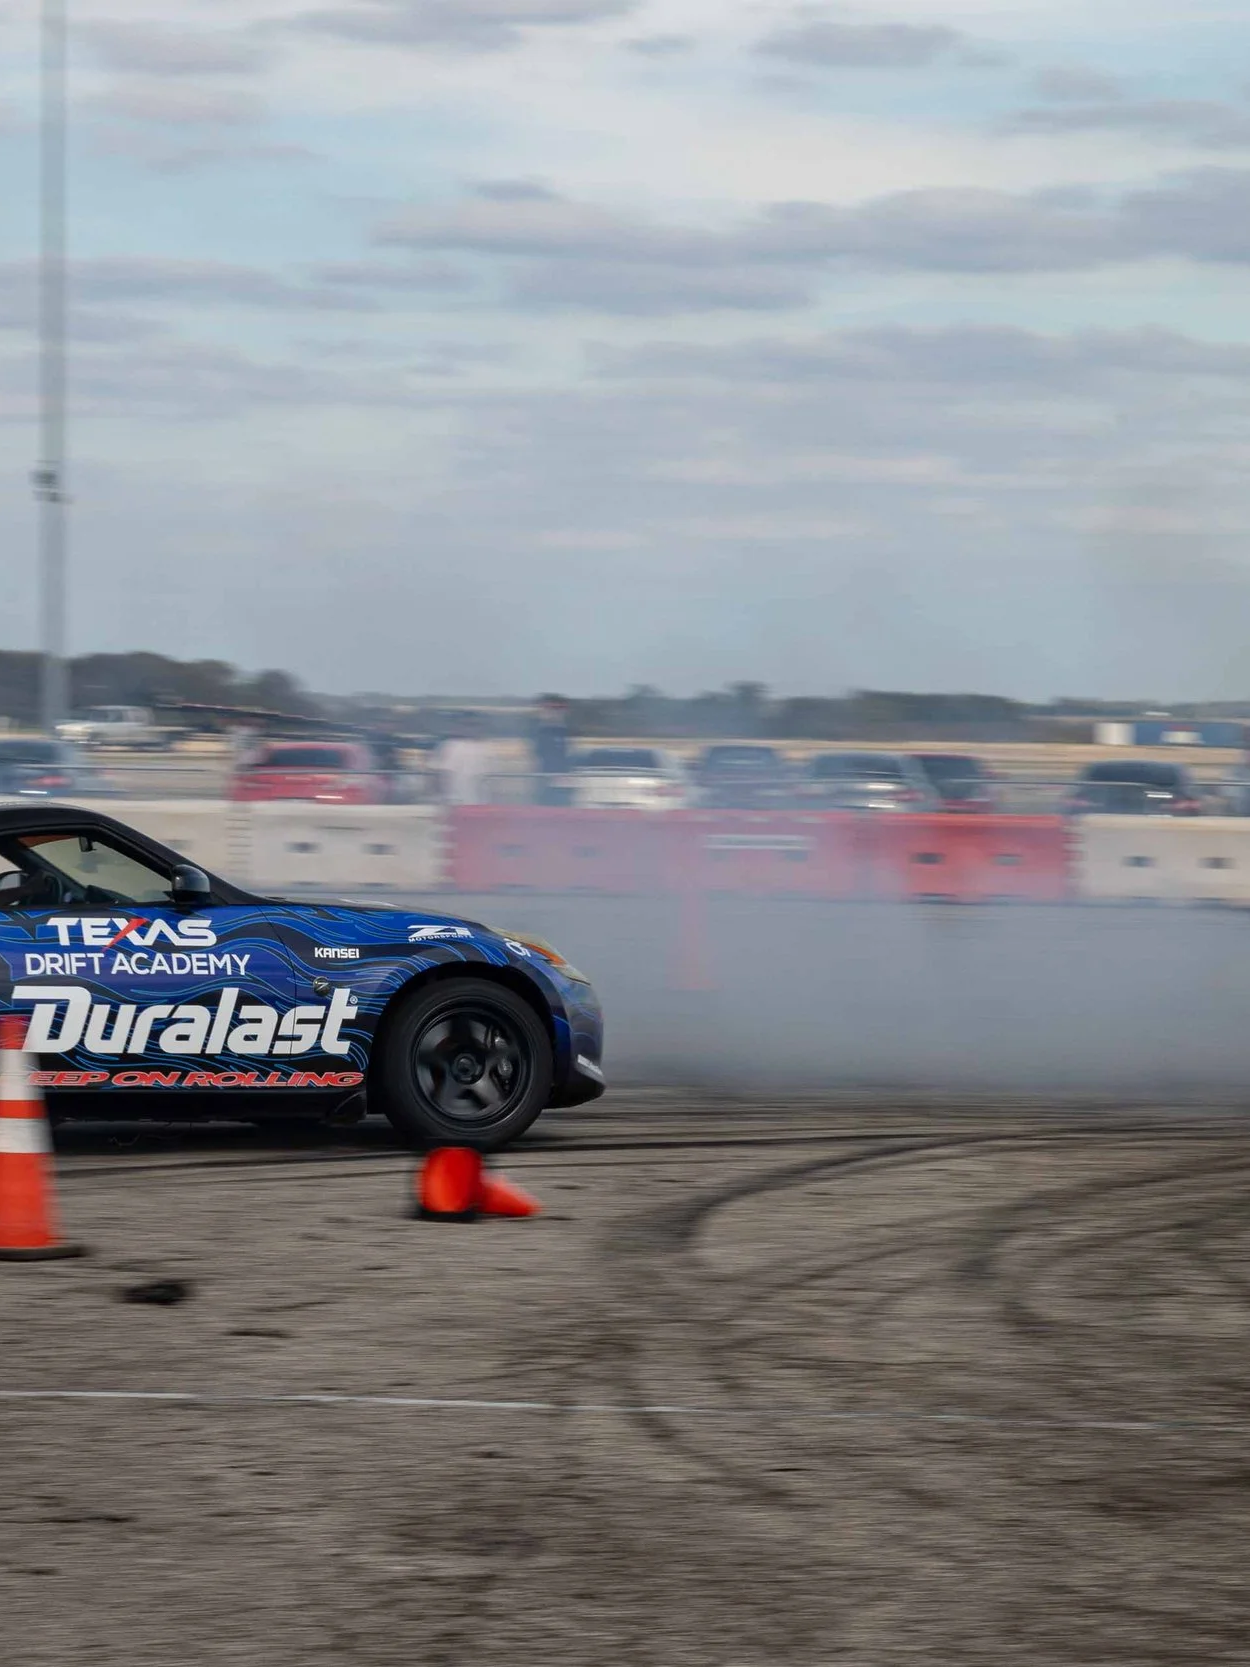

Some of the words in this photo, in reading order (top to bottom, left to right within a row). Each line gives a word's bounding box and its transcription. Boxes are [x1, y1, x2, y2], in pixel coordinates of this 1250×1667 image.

[47, 917, 218, 952] TEXAS
[314, 946, 360, 959] KANSEI
[25, 953, 105, 975] DRIFT
[111, 954, 250, 976] ACADEMY
[111, 1071, 178, 1087] ON
[180, 1071, 364, 1087] ROLLING
